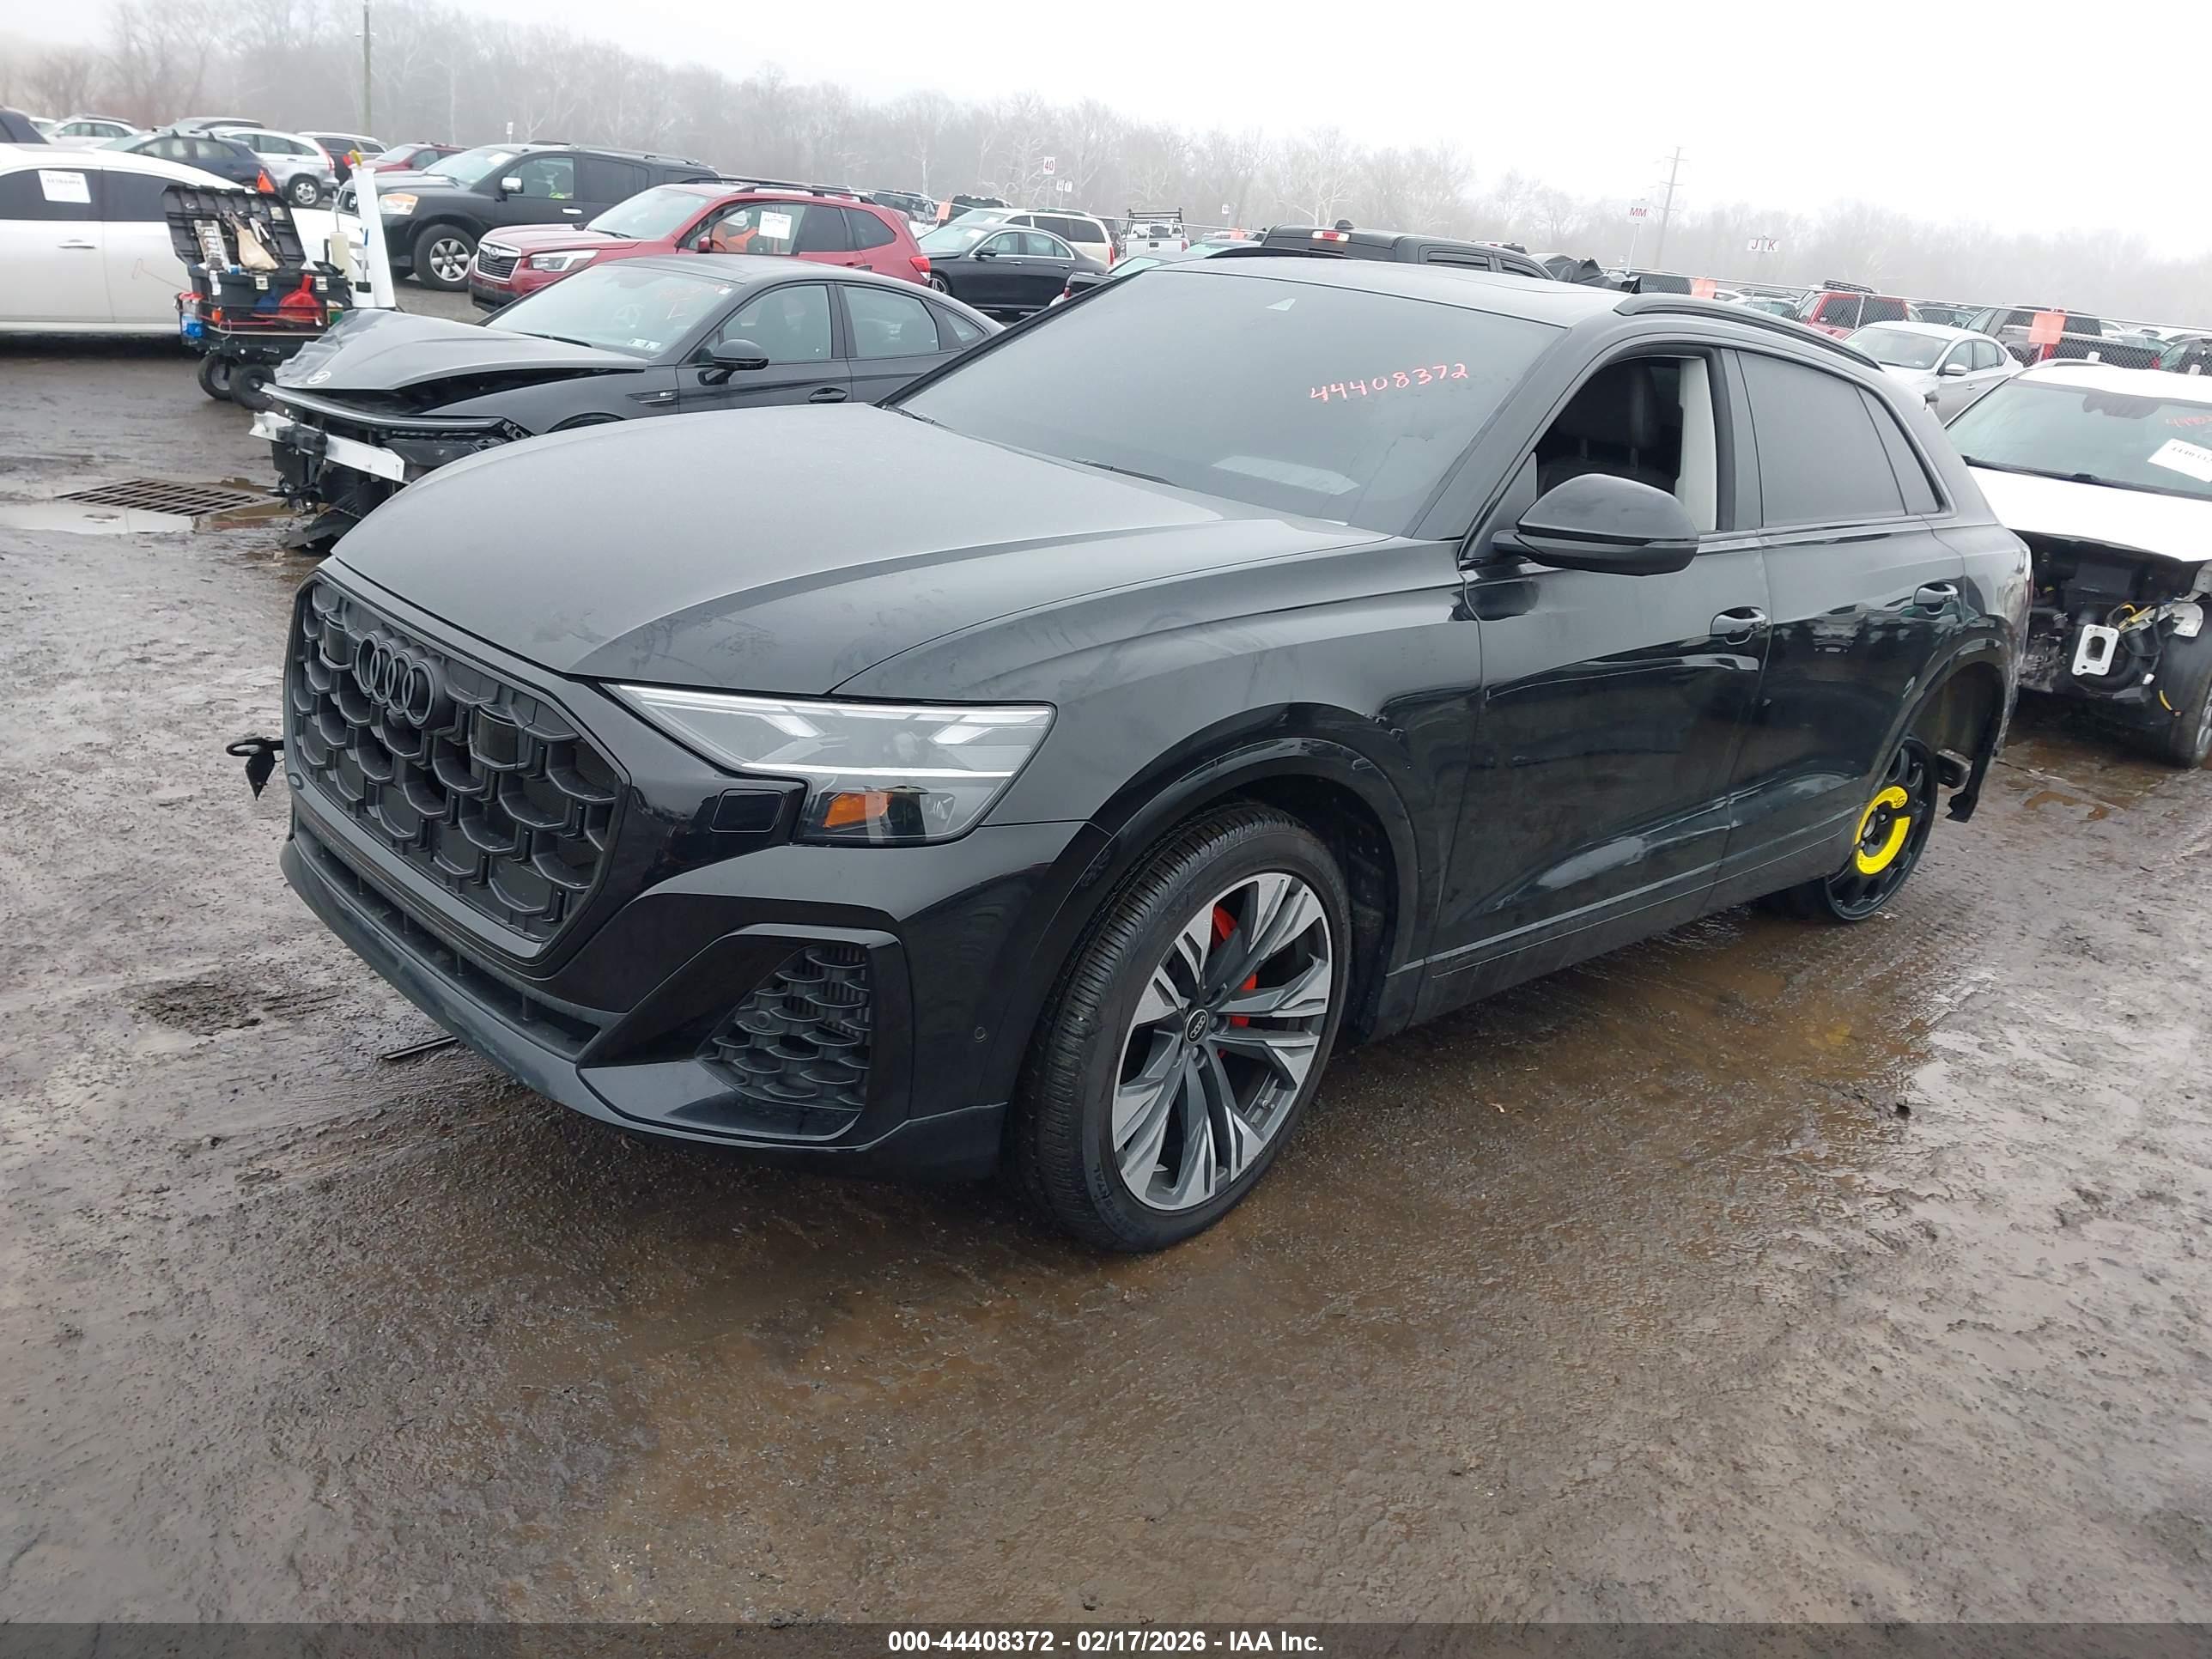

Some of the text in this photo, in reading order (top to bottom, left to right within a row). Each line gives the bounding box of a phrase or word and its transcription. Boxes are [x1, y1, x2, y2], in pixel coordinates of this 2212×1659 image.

[1044, 160, 1054, 171] 40
[1629, 207, 1647, 217] MM
[1751, 240, 1778, 251] J K
[1310, 363, 1468, 401] 44408372
